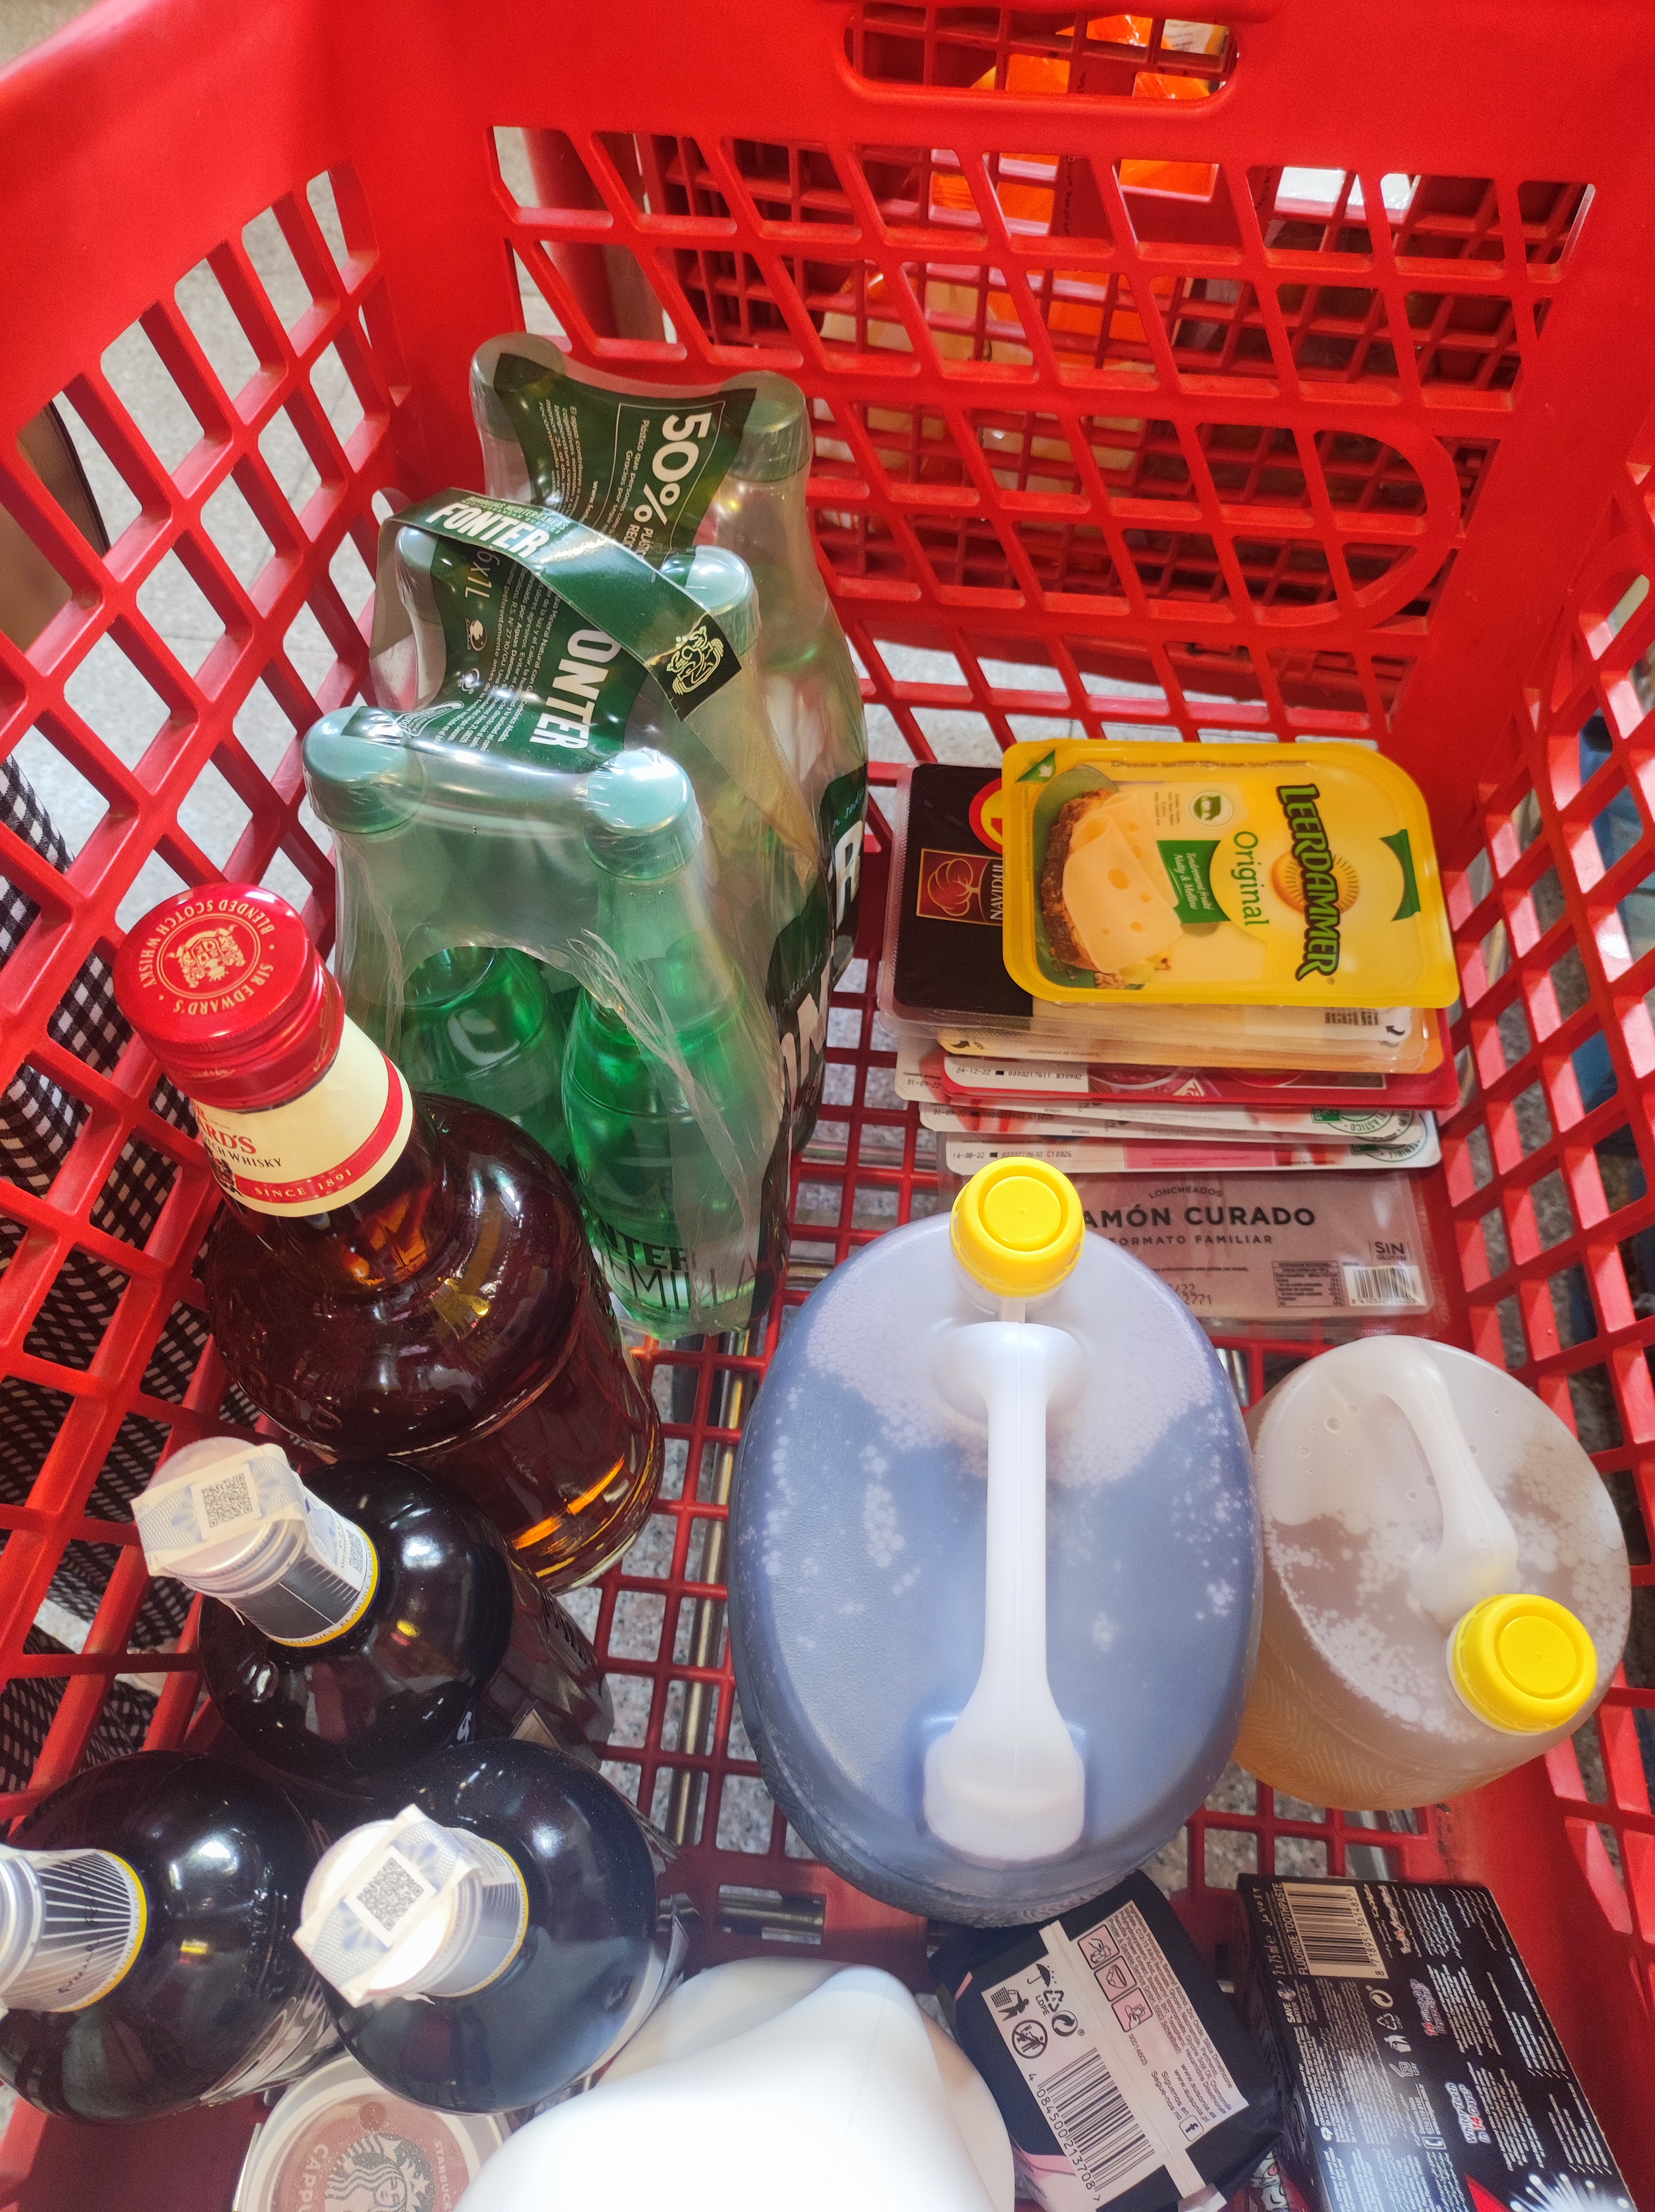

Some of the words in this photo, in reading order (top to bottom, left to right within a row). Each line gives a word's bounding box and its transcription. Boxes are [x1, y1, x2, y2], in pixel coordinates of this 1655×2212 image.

[620, 451, 632, 485] Gracias
[633, 412, 712, 525] 50%
[425, 502, 550, 558] FONTER
[494, 585, 509, 657] preferentemente
[512, 622, 522, 648] Aguas
[535, 617, 543, 628] luz
[542, 609, 557, 638] Mineral
[488, 658, 497, 681] antes
[502, 649, 517, 682] Danone,
[514, 652, 525, 675] Evitar
[533, 639, 548, 669] Natural
[495, 669, 503, 684] Una
[529, 669, 537, 684] con
[529, 629, 621, 749] ONTER
[1231, 831, 1269, 926] Original
[1276, 783, 1340, 982] LEERDAMMER
[156, 900, 214, 935] SCOTCH
[219, 900, 275, 934] BLENDED
[139, 938, 158, 988] WHISKY
[251, 964, 274, 985] SIR
[174, 984, 254, 1015] EDWARD'S
[956, 1067, 991, 1075] 24-12-22
[227, 1150, 282, 1167] WHISKY
[255, 1187, 306, 1198] SINCE
[318, 1169, 352, 1190] 1891
[1149, 1187, 1222, 1199] LONCHEADOS
[1083, 1204, 1171, 1228] AMÓN
[1184, 1207, 1315, 1227] CURADO
[1195, 1235, 1272, 1244] FAMILIAR
[1375, 1241, 1405, 1254] SIN
[1272, 1883, 1295, 1932] TOOTHPASTE
[1349, 1896, 1366, 1927] 361485
[1134, 1927, 1149, 1948] C12-15
[1144, 1947, 1157, 1963] Alkyl
[1287, 1936, 1308, 1975] FLUORIDE
[1360, 1932, 1380, 1963] 718951
[1106, 1918, 1122, 1939] Procter
[1120, 1943, 1136, 1966] Gamble
[1132, 1965, 1147, 1986] Service
[1161, 2020, 1183, 2054] Schwalbach
[1034, 1994, 1050, 2016] LDPE
[1124, 1937, 1139, 1957] Flower
[1183, 2048, 1206, 2082] Hexamidine
[1283, 2002, 1295, 2023] SAVE
[1292, 2002, 1302, 2023] WATER
[1160, 1963, 1178, 1987] Behenyl
[1185, 2007, 1196, 2020] Zinc
[1202, 2038, 1215, 2055] Silica
[1210, 2054, 1234, 2089] Dimethicone
[1421, 2022, 1437, 2035] 14
[1126, 2033, 1149, 2066] 90014603
[1196, 2056, 1208, 2071] Soja
[1150, 2070, 1177, 2112] Segue-nos
[1173, 2110, 1183, 2121] no
[1159, 2070, 1185, 2108] Síguenos
[1181, 2106, 1189, 2116] en
[1172, 2069, 1209, 2124] www.ausonia.pt
[1180, 2063, 1216, 2119] www.ausonia.es
[1447, 2083, 1463, 2108] Teeth
[1026, 2072, 1037, 2082] 4
[1034, 2088, 1069, 2140] 084500
[1062, 2139, 1097, 2192] 213708
[1456, 2110, 1475, 2141] Whiter
[1470, 2116, 1483, 2129] 14
[1479, 2132, 1489, 2141] In
